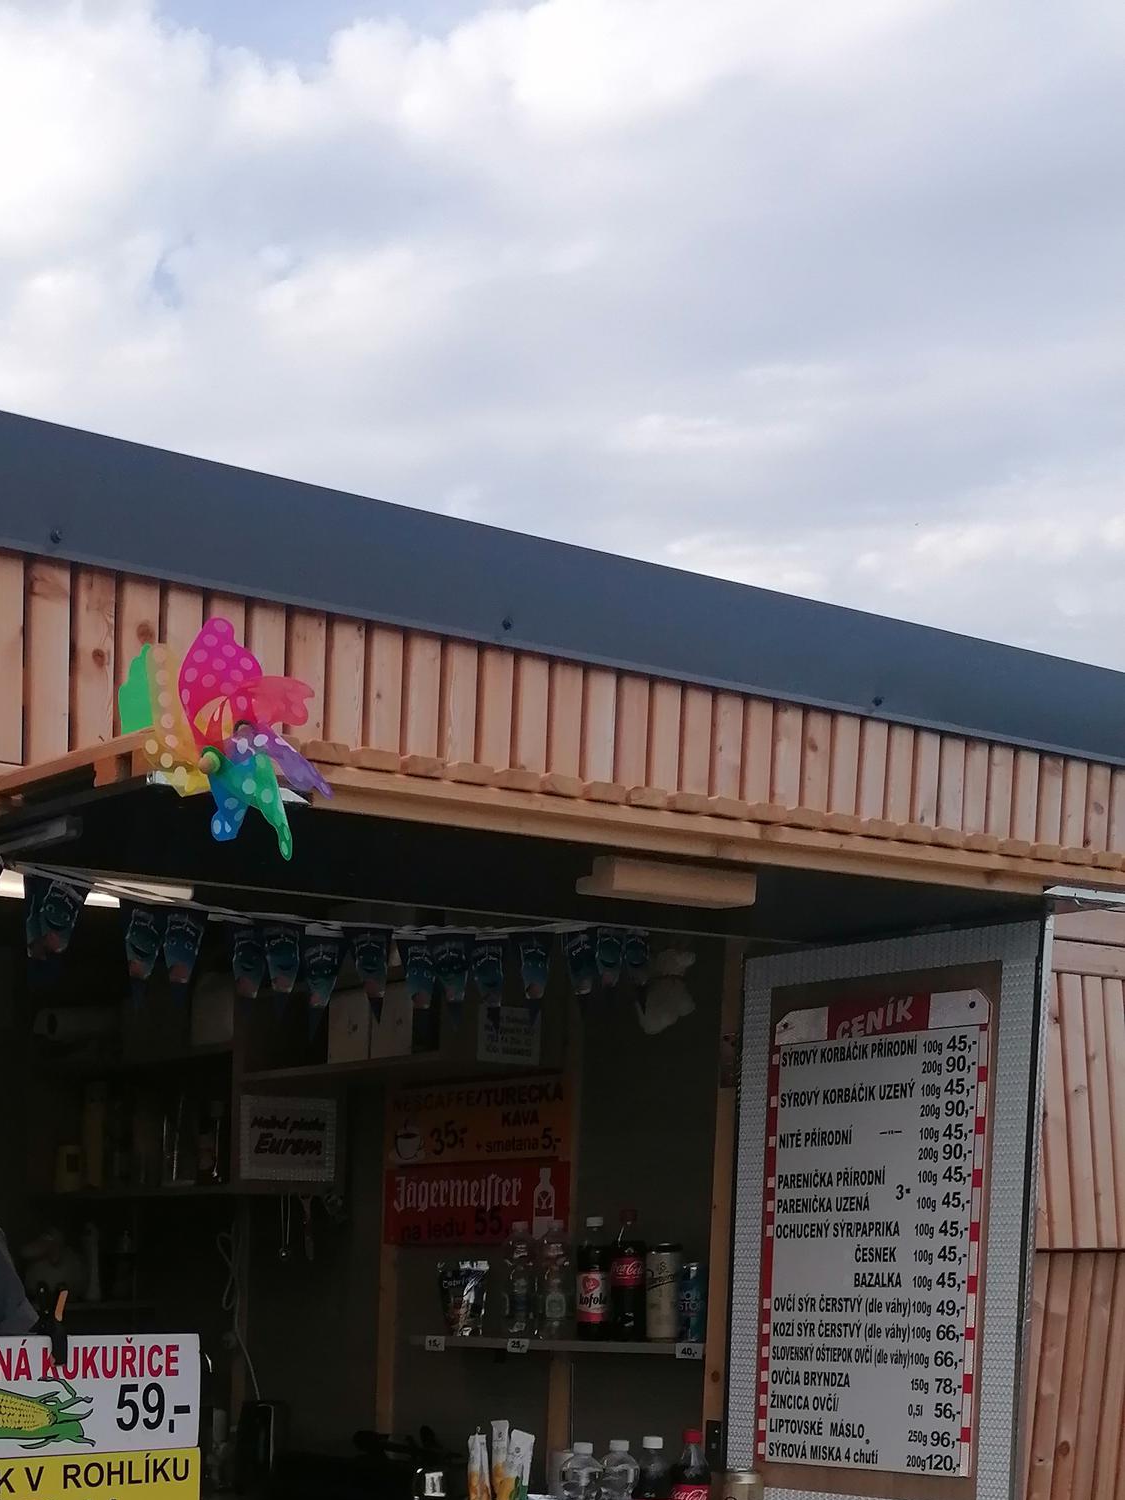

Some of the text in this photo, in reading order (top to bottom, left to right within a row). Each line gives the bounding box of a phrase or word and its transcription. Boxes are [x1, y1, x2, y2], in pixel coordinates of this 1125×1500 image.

[836, 996, 913, 1038] CENÍK
[781, 1034, 977, 1067] SÝROVÝ KORBÁČIK PŘÍRODNÍ 45,-
[946, 1055, 976, 1073] 90,-
[780, 1078, 916, 1108] SÝROVÝ KORBÁČIK UZENÝ
[804, 1125, 853, 1146] PŘÍRODNÍ
[778, 1166, 886, 1189] PARENIČKA PŘÍRODNÍ
[777, 1192, 870, 1214] PARENIČKA UZENÁ
[775, 1219, 900, 1239] OCHUCENÝ SÝR/PAPRIKA
[854, 1244, 897, 1263] ČESNEK
[854, 1272, 902, 1288] BAZALKA
[936, 1300, 965, 1317] 49,-
[681, 1347, 697, 1357] 40,-
[771, 1369, 850, 1388] OVČIA BRYNDZA
[769, 1417, 960, 1449] LIPTOVSKÉ MÁSLO 250g 96,-
[24, 1466, 44, 1492] V
[63, 1453, 190, 1490] ROHLÍKU
[926, 1454, 960, 1472] 120,-
